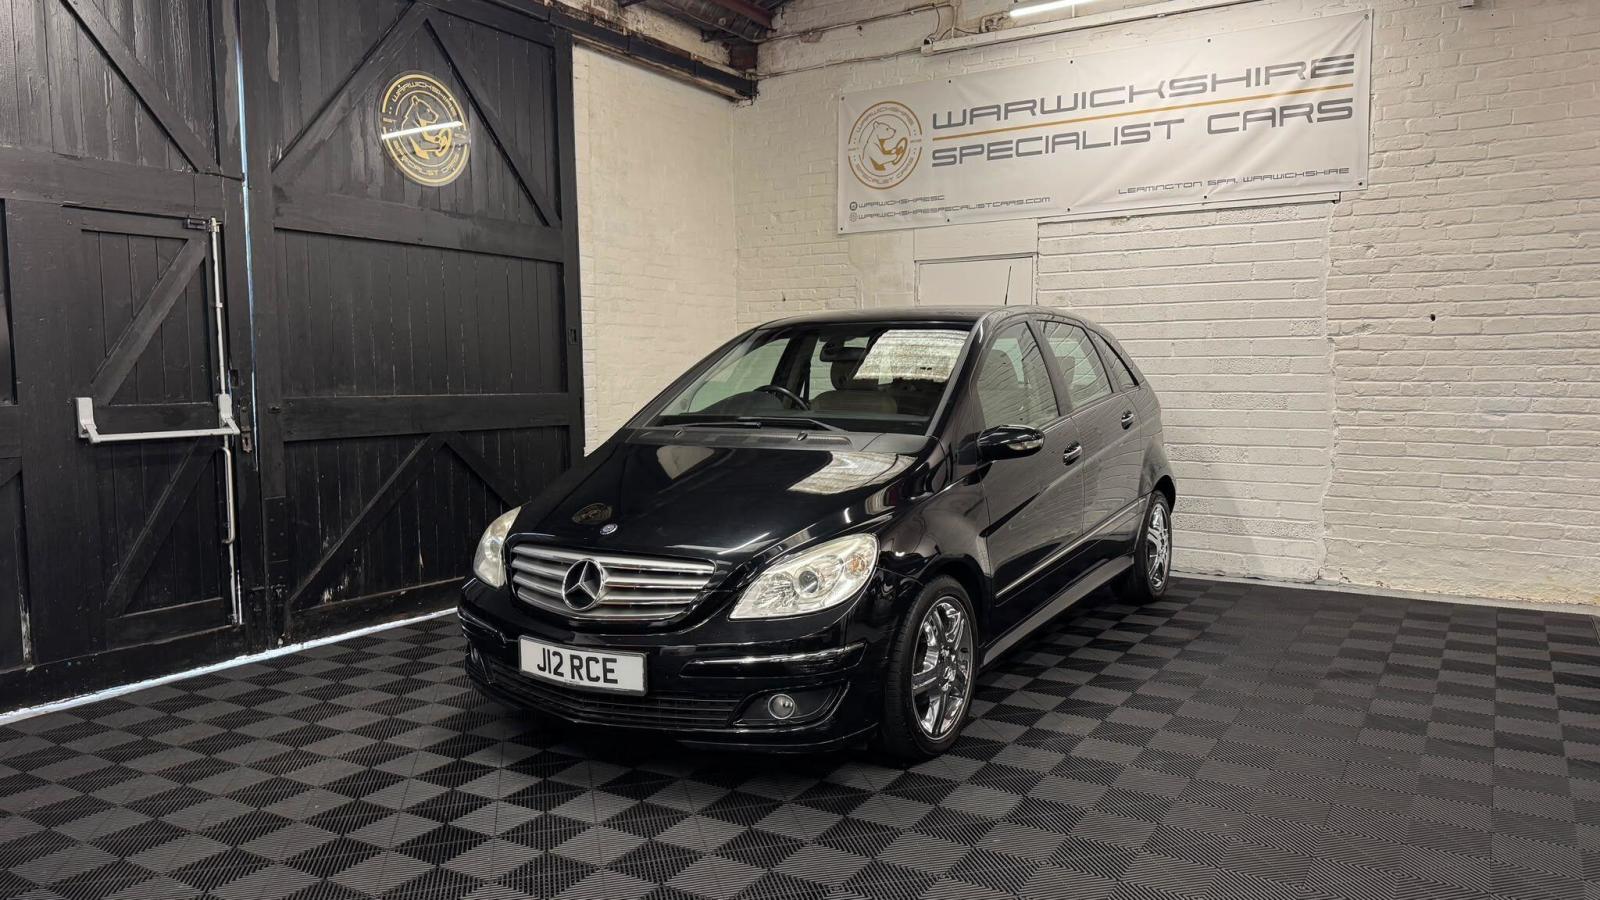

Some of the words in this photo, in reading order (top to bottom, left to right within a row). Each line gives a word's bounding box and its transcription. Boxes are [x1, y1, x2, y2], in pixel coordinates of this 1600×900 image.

[392, 81, 457, 117] WARWICKSHIRE
[932, 53, 1355, 130] WARWICKSHIRE
[931, 118, 1185, 168] SPECIALIST
[1207, 97, 1354, 135] CARS
[1118, 181, 1203, 195] LEAMINGTON
[1242, 167, 1350, 183] WARWICKSHIRE
[537, 647, 565, 678] J12
[569, 653, 619, 685] RCE
